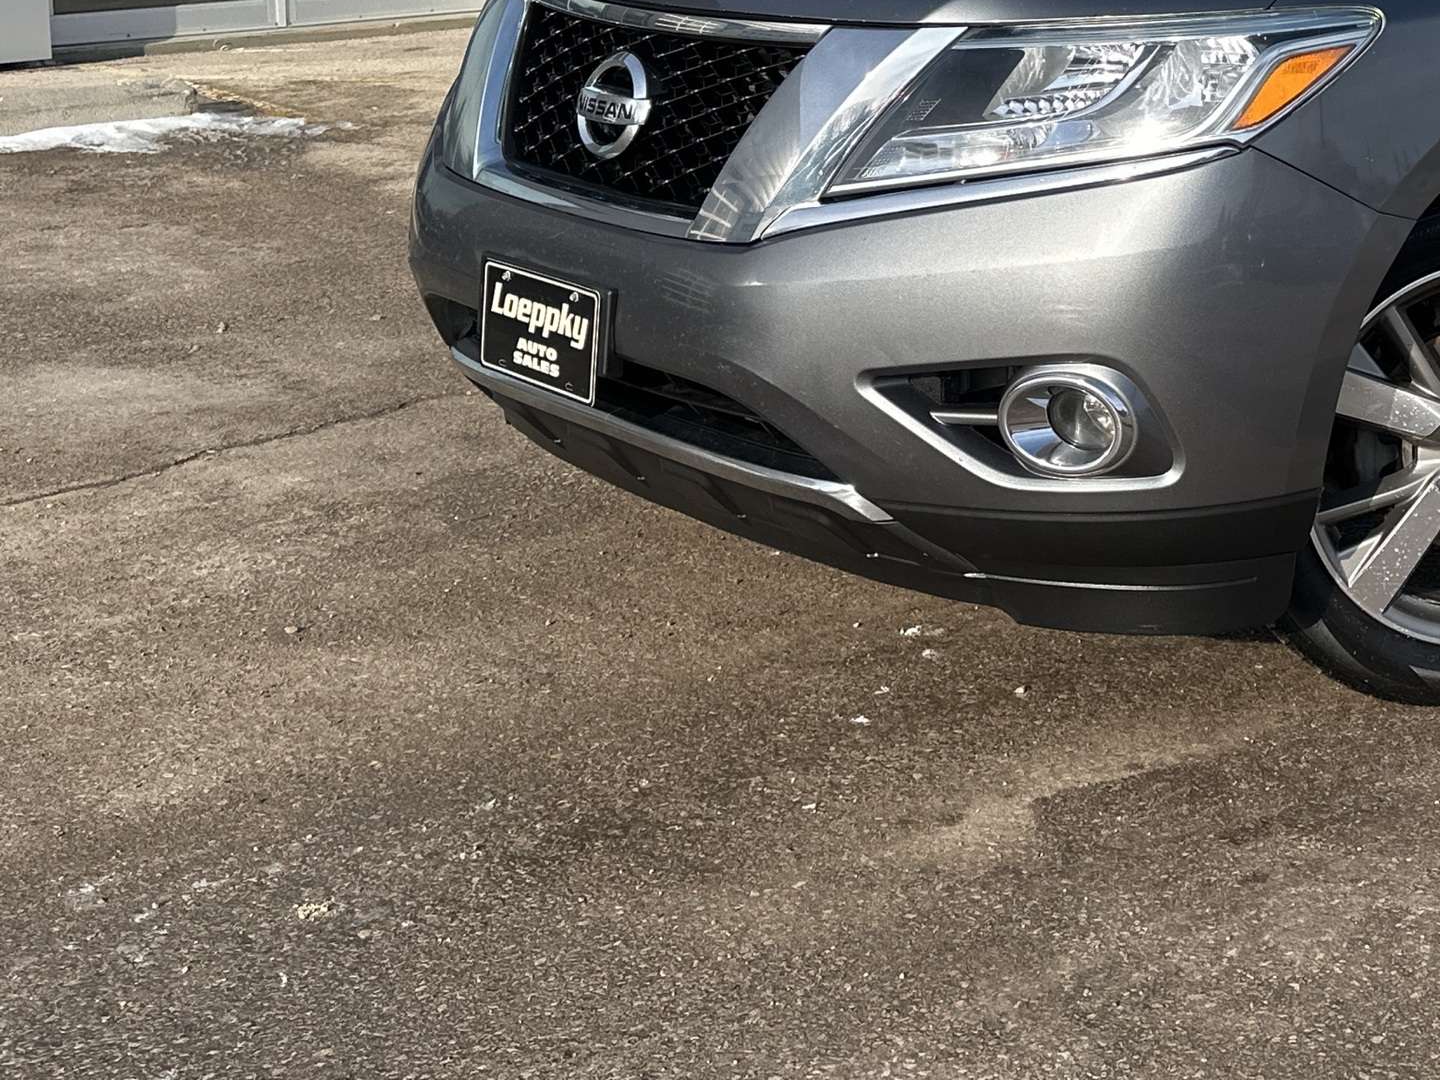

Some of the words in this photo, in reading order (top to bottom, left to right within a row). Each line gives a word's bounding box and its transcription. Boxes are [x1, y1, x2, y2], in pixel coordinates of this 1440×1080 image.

[578, 94, 634, 120] NISSAN
[491, 281, 589, 351] Loeppky
[516, 337, 558, 361] AUTO
[513, 351, 560, 378] SALES
